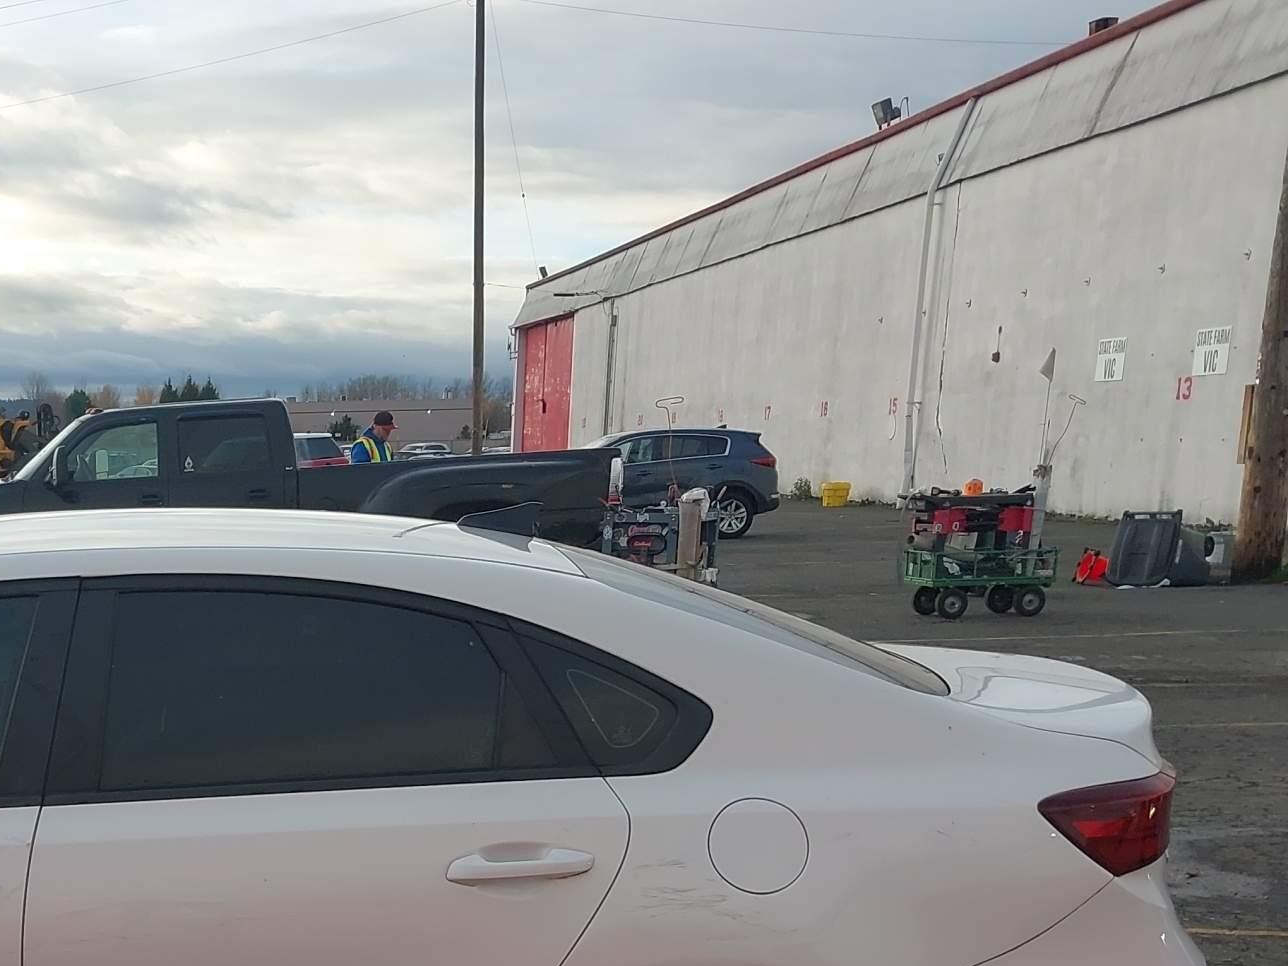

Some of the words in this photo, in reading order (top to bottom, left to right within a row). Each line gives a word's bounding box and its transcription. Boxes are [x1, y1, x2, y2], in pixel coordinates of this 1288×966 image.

[1196, 329, 1213, 347] STATE
[1214, 328, 1230, 345] FARM
[1103, 358, 1117, 379] VIC
[1203, 350, 1218, 373] VIC
[1175, 376, 1193, 401] 13
[888, 398, 898, 416] 15
